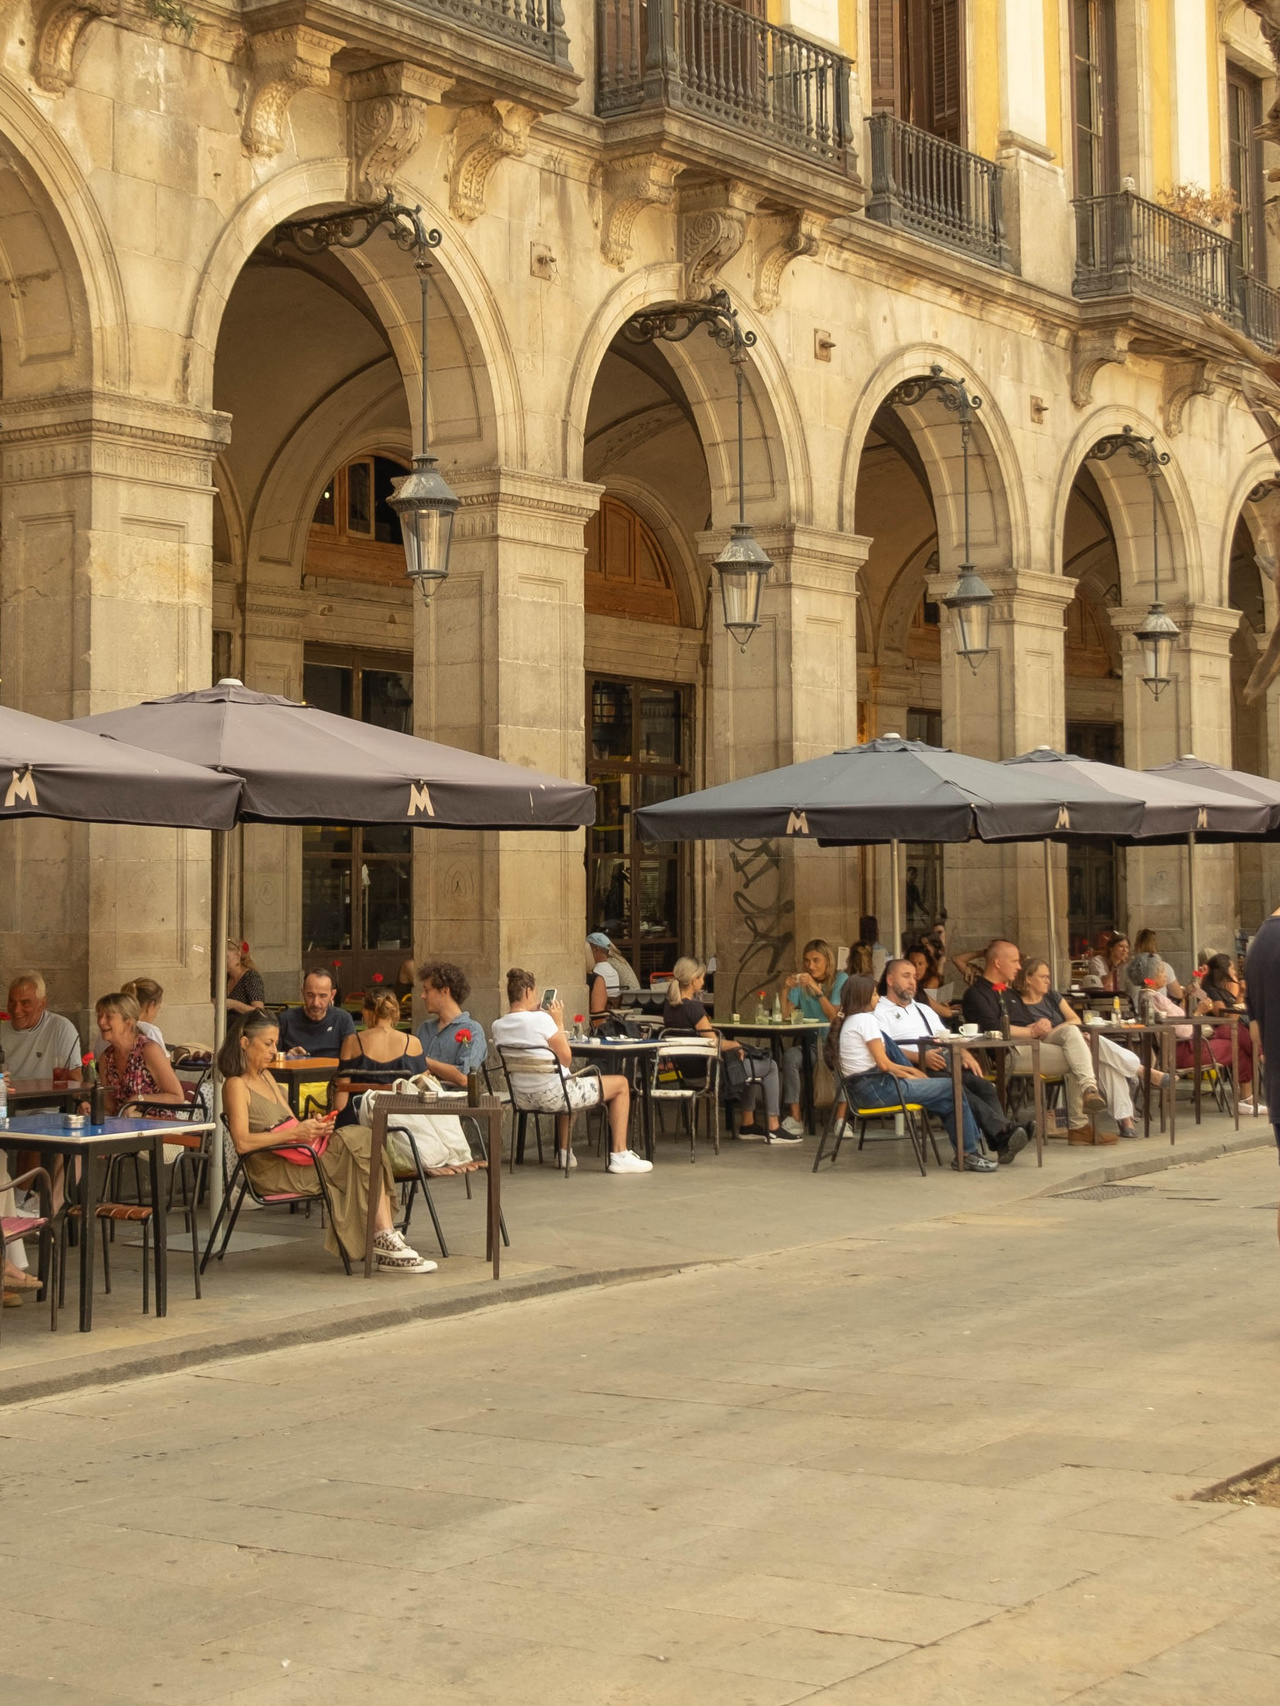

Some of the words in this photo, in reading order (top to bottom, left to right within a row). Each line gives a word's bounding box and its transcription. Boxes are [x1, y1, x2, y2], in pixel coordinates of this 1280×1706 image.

[5, 770, 39, 807] M
[407, 783, 435, 816] M
[786, 811, 809, 834] M
[1055, 806, 1070, 828] M
[1196, 807, 1208, 828] M
